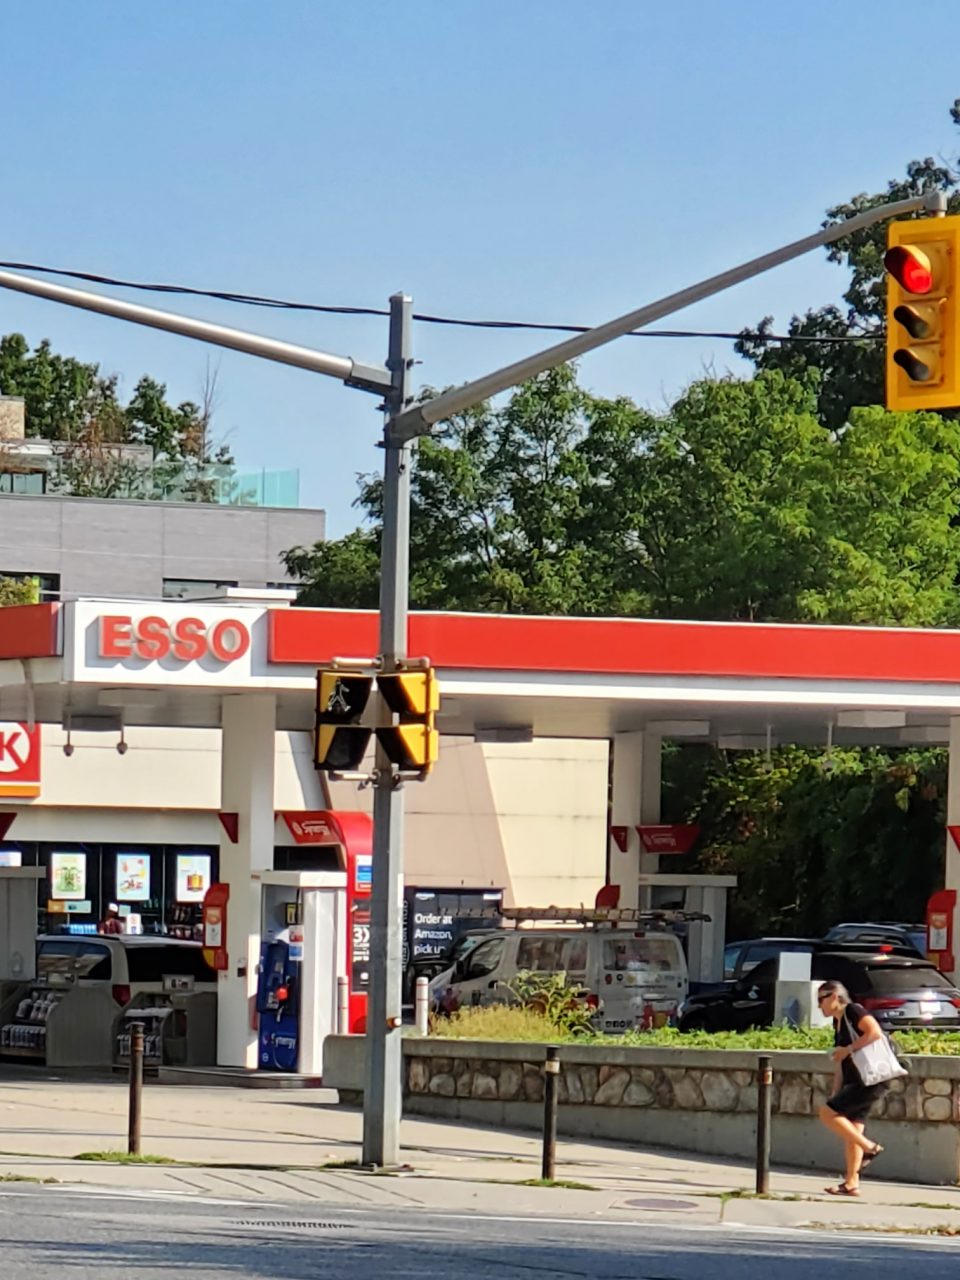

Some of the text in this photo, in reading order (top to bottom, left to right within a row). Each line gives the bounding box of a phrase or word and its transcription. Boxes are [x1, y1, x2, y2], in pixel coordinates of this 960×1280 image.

[98, 615, 250, 662] ESSO
[414, 913, 441, 925] Order
[414, 943, 432, 956] pick
